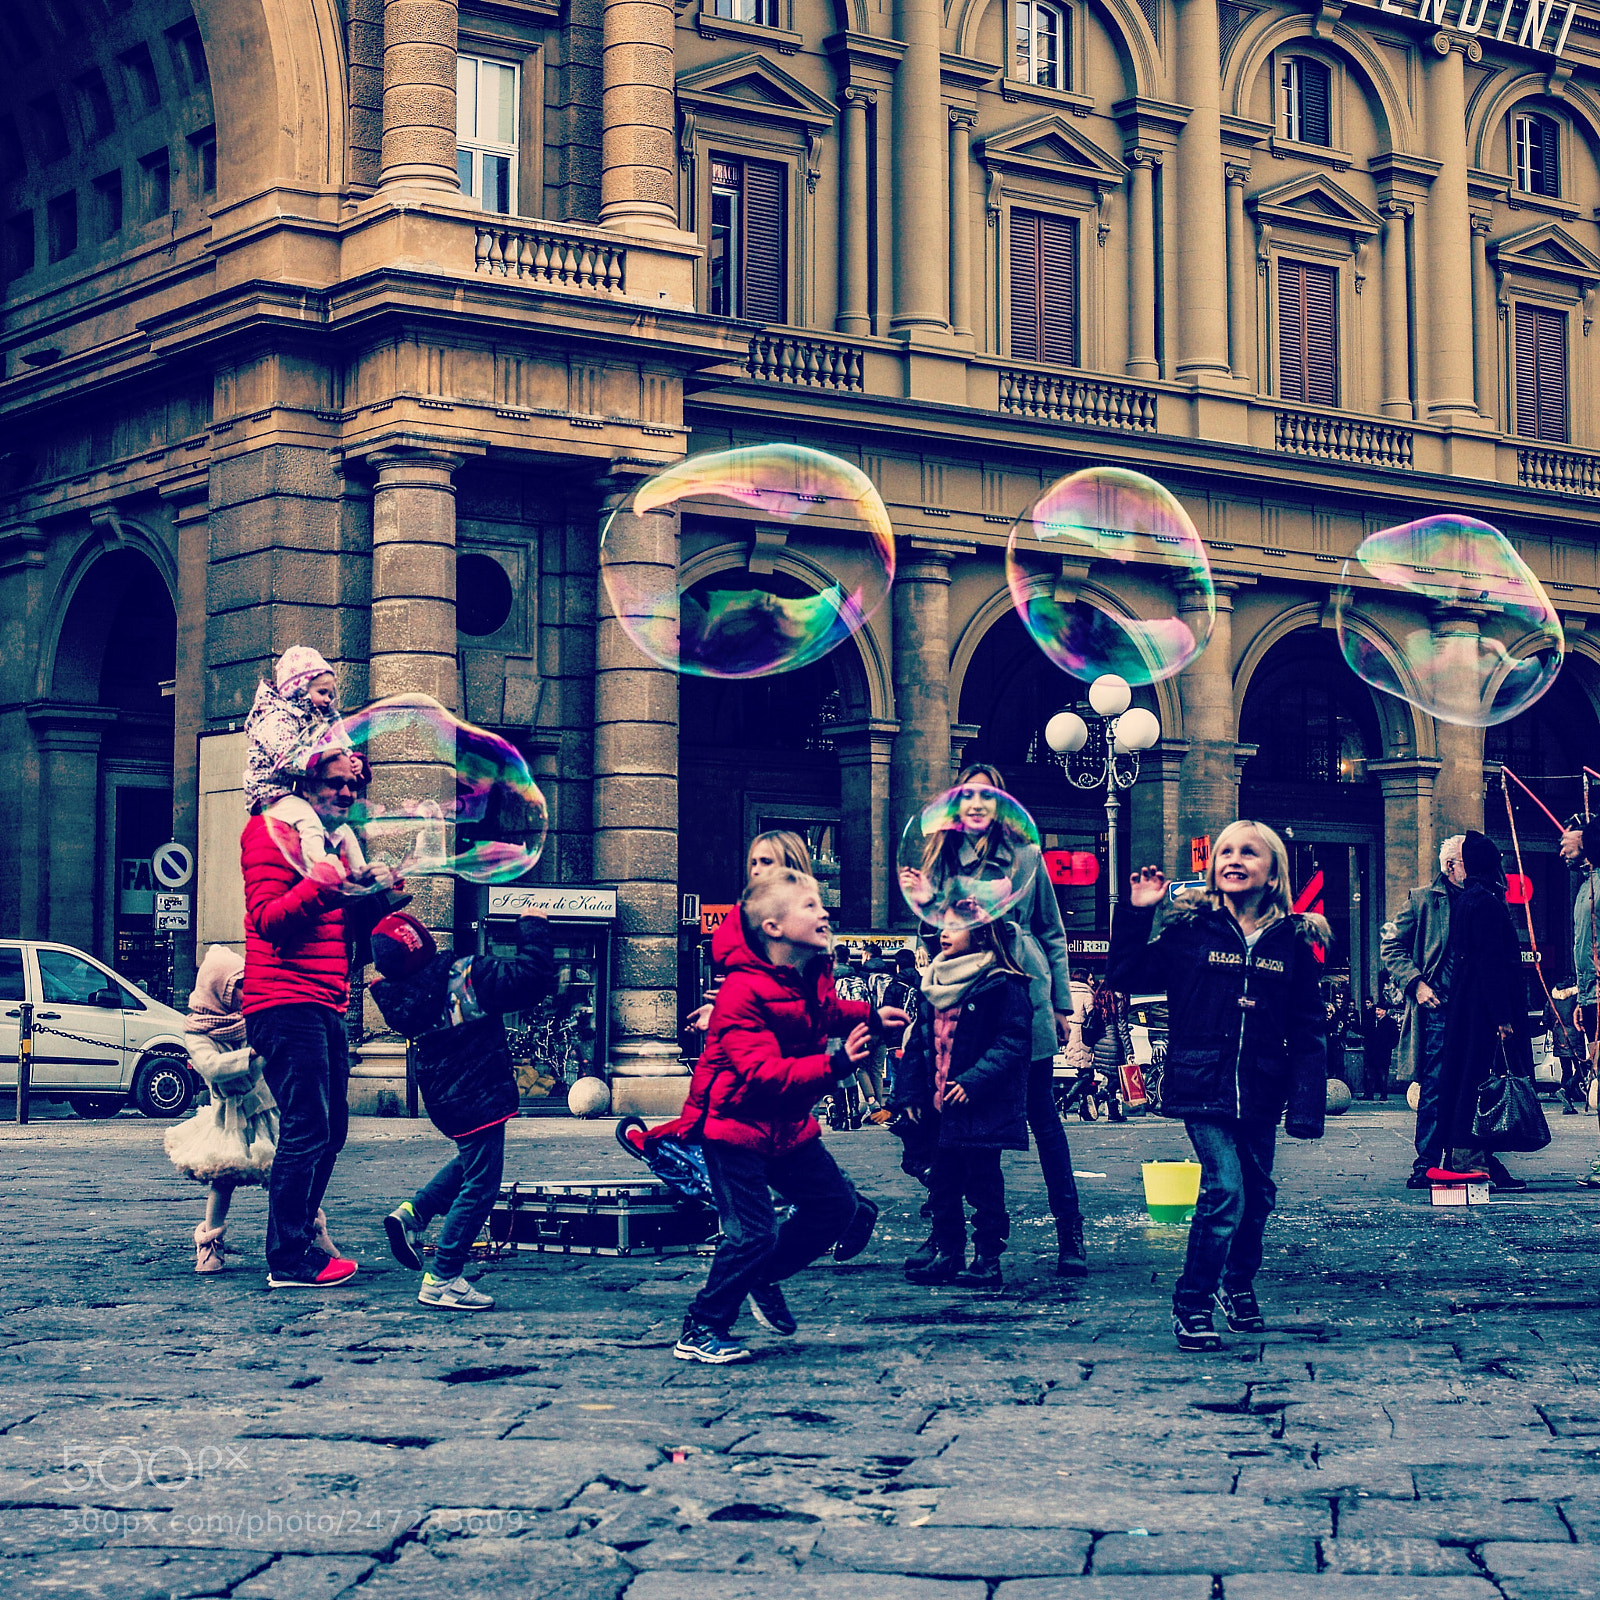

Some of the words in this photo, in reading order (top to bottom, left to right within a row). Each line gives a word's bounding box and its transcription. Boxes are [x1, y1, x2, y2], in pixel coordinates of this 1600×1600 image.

[1380, 0, 1577, 57] NDINI
[510, 893, 550, 909] Fiori
[552, 896, 567, 910] di
[568, 895, 613, 911] Katia
[703, 912, 729, 926] TAX
[845, 939, 859, 948] LA
[1083, 940, 1110, 953] RED
